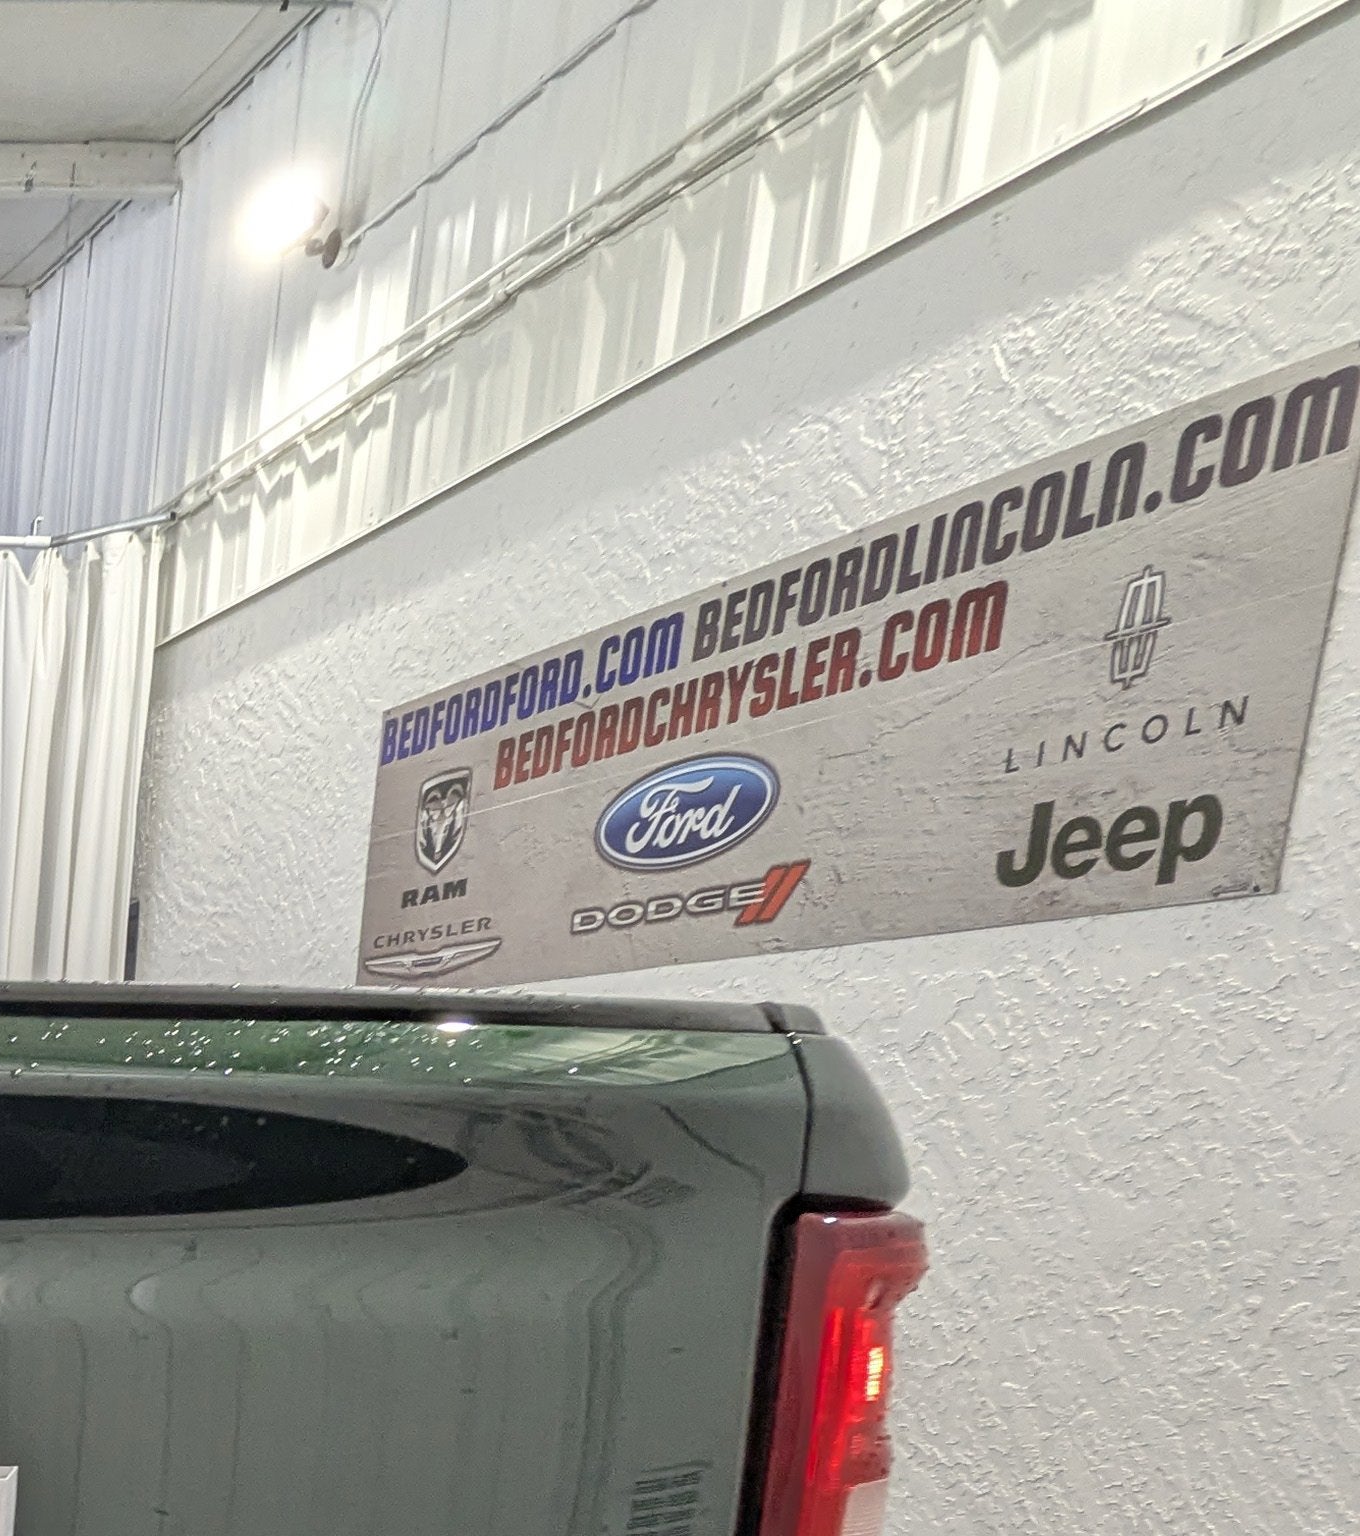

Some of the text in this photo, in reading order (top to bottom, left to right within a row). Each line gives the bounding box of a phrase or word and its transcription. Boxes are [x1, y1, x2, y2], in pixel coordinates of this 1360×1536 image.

[380, 364, 1360, 766] BEDFORDFORD.COM BEDFORDLINCOLN.COM
[493, 580, 1009, 791] BEDFORDCHRYSLER.COM
[1004, 696, 1249, 773] LINCOLN
[625, 775, 743, 854] Ford
[995, 793, 1223, 888] Jeep
[400, 878, 468, 909] RAM
[570, 879, 768, 935] DODGE
[373, 917, 492, 949] CHRYSLER
